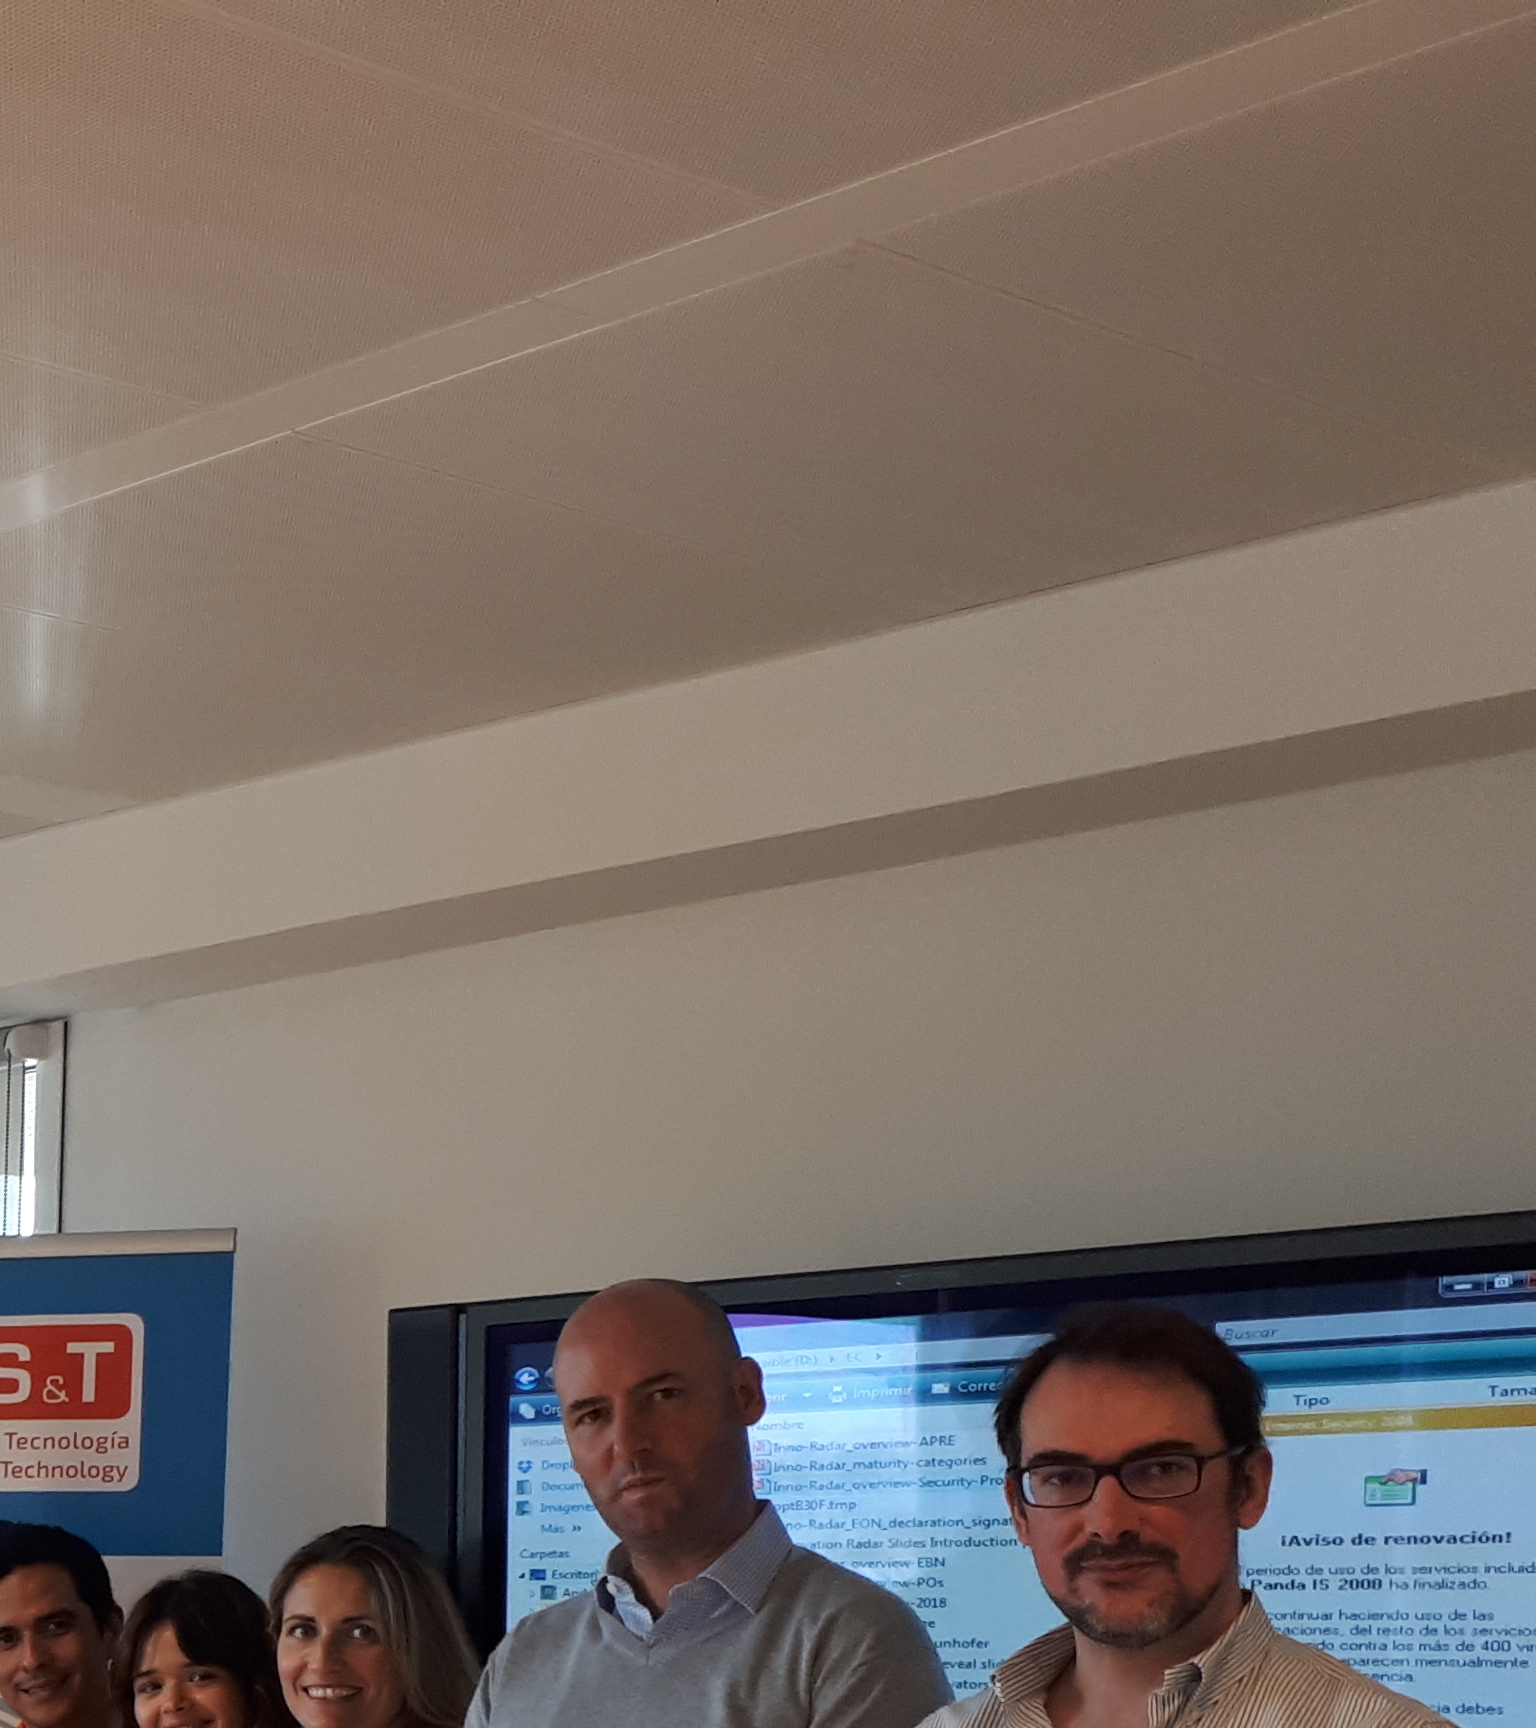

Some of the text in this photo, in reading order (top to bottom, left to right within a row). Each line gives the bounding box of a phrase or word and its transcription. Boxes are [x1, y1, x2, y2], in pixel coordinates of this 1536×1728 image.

[1224, 1327, 1279, 1341] Buscar
[1292, 1394, 1330, 1409] Tipo
[4, 1431, 130, 1454] Tecnología
[0, 1460, 129, 1484] Technology
[847, 1537, 882, 1550] Radar
[930, 1535, 1018, 1549] Introduction
[1351, 1533, 1377, 1546] de
[1384, 1530, 1512, 1545] renovación!
[519, 1548, 571, 1561] Carpetas
[1246, 1564, 1301, 1578] periodo
[1305, 1564, 1324, 1575] de
[1329, 1566, 1356, 1576] uso
[1360, 1563, 1380, 1575] de
[1384, 1563, 1405, 1575] los
[1411, 1563, 1479, 1575] servicios
[1250, 1579, 1307, 1591] Panda
[1312, 1579, 1330, 1591] IS
[1389, 1579, 1409, 1590] ha
[1338, 1609, 1409, 1621] haciendo
[1415, 1612, 1442, 1621] uso
[1448, 1609, 1467, 1621] de
[1472, 1609, 1495, 1621] las
[1350, 1625, 1372, 1636] del
[1376, 1625, 1414, 1636] resto
[1419, 1624, 1438, 1636] de
[1443, 1624, 1465, 1636] los
[1339, 1640, 1388, 1651] contra
[1392, 1640, 1414, 1652] los
[1418, 1640, 1449, 1652] más
[1455, 1640, 1475, 1652] de
[1480, 1639, 1511, 1652] 400
[1414, 1656, 1530, 1669] mensualmente
[1455, 1702, 1504, 1715] debes
